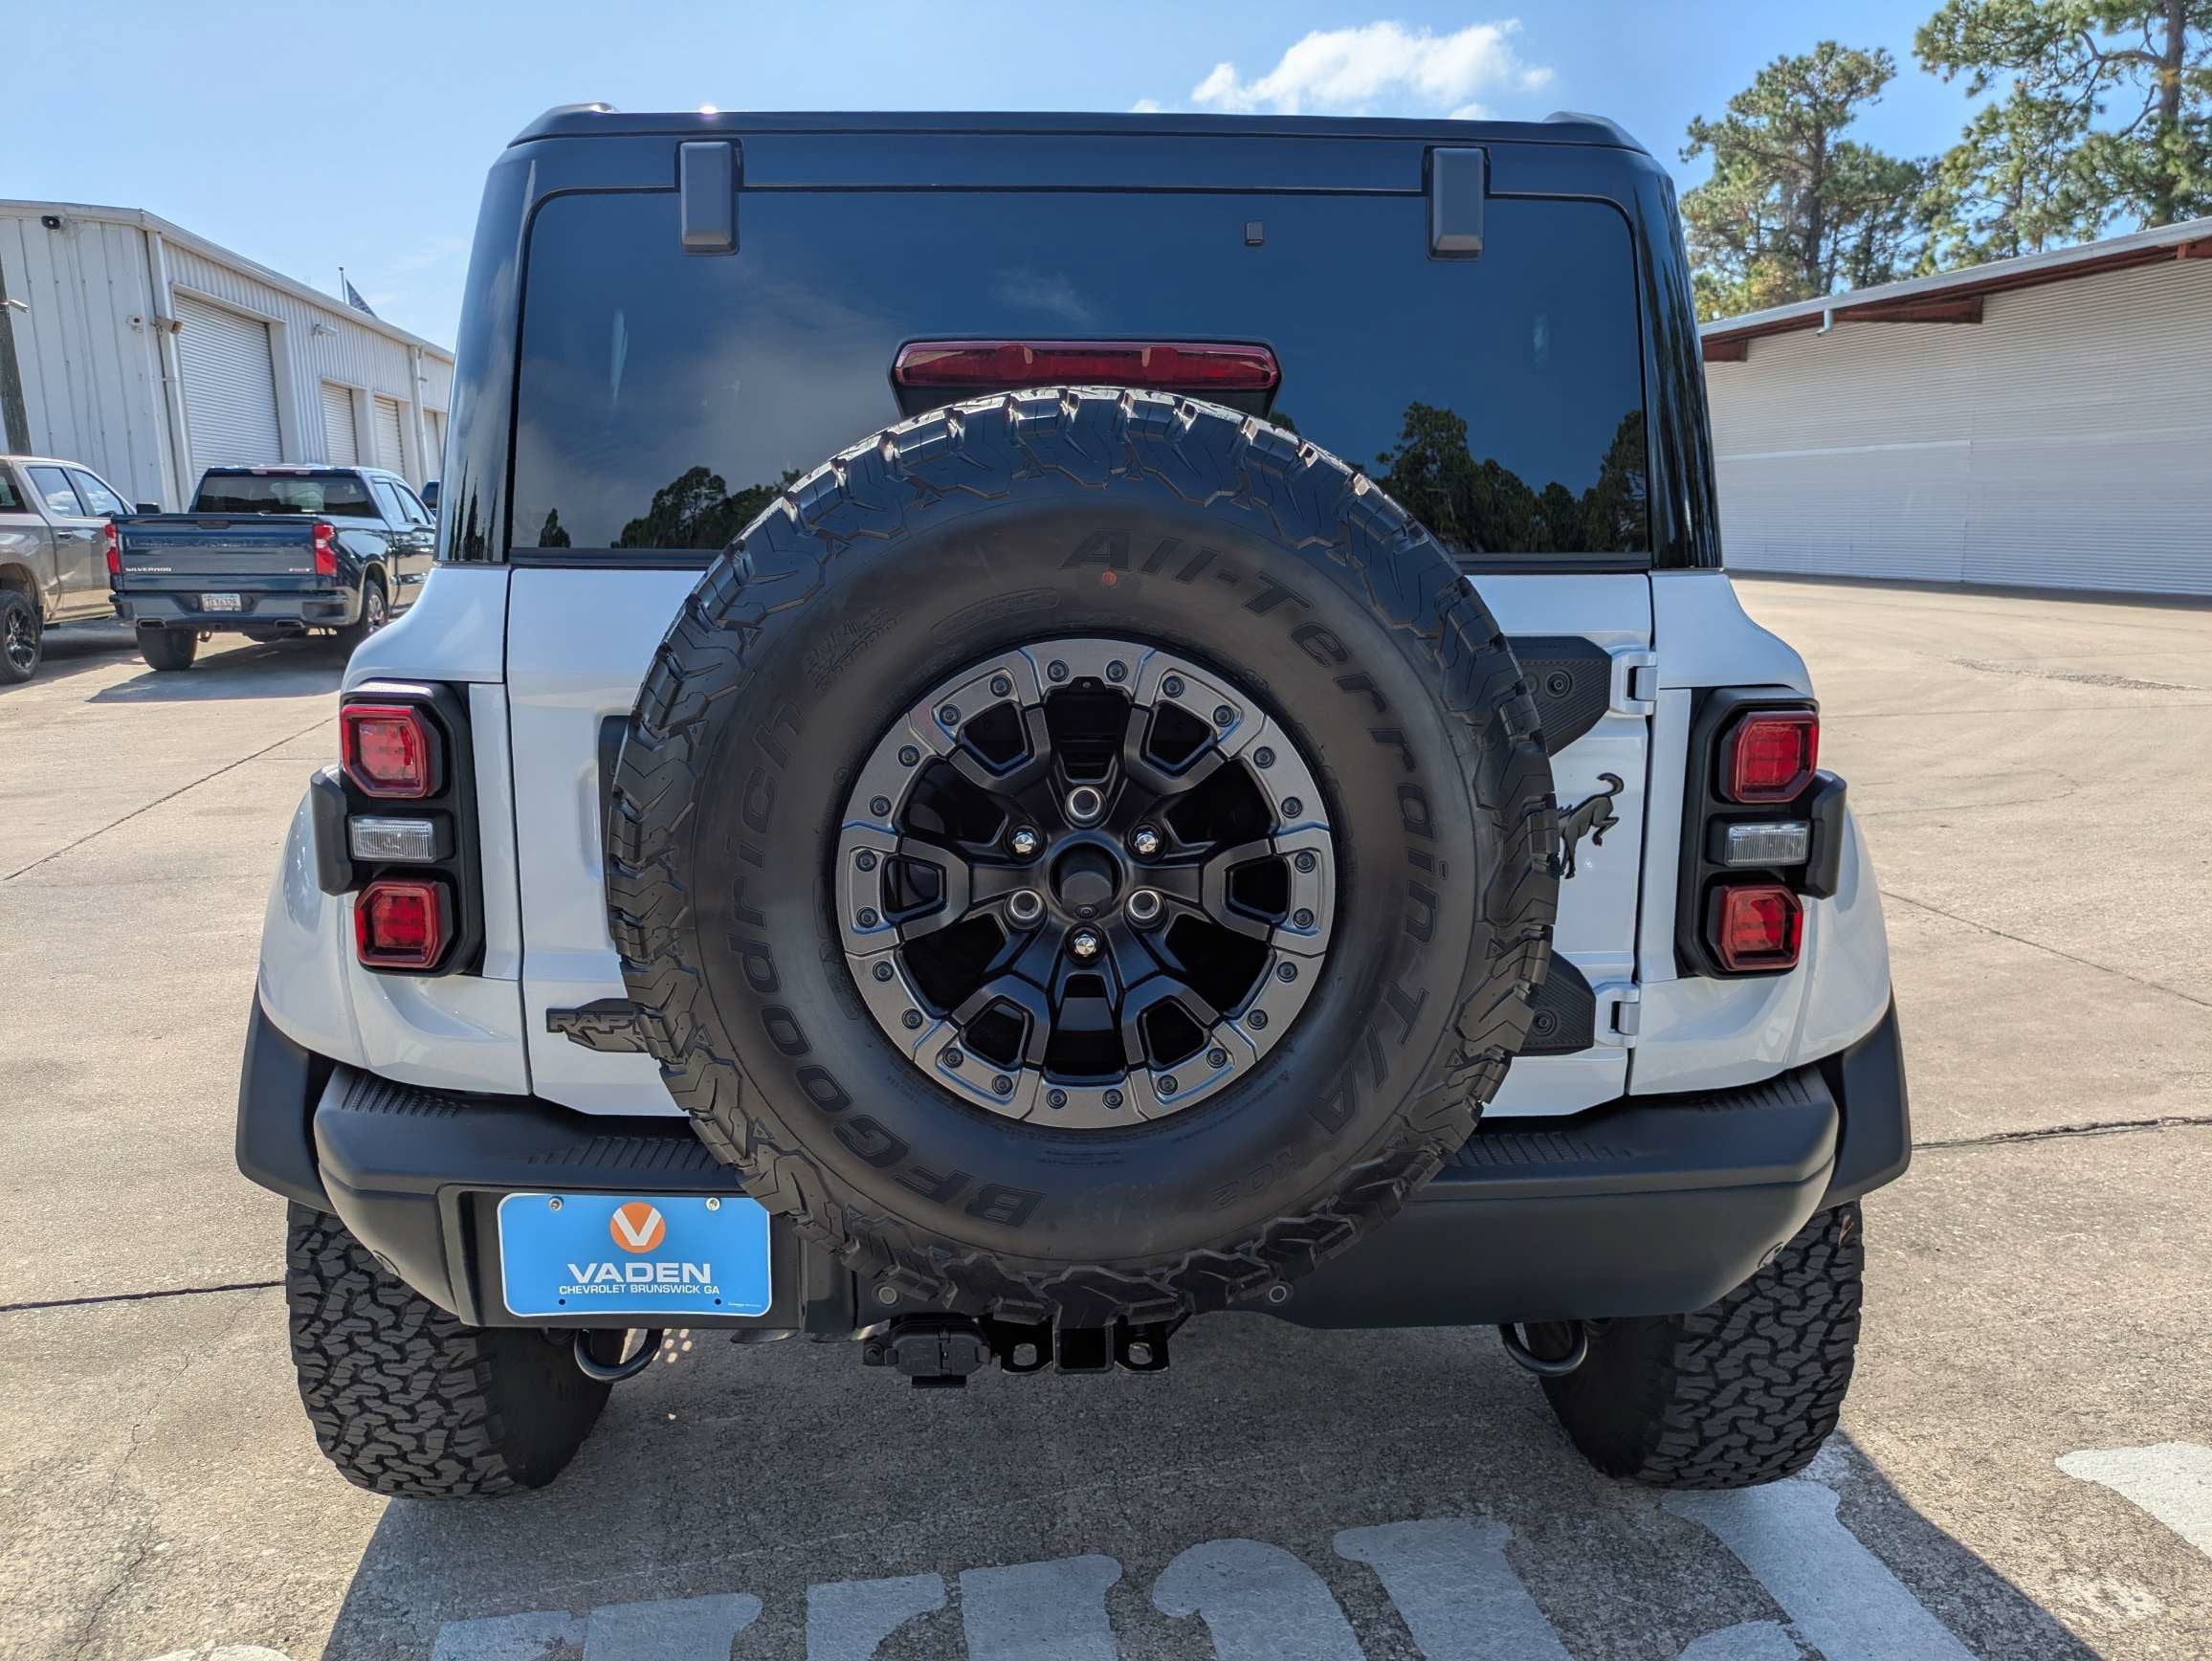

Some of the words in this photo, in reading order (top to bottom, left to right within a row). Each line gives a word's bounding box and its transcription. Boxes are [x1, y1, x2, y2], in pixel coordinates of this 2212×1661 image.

[727, 702, 1047, 1228] BFGoodrich
[1059, 529, 1449, 944] All-Terrain
[1308, 982, 1430, 1137] T/A
[559, 1284, 627, 1296] CHEVROLET
[630, 1284, 701, 1296] BRUNSWICK
[703, 1285, 720, 1296] GA
[567, 1262, 712, 1284] VADEN
